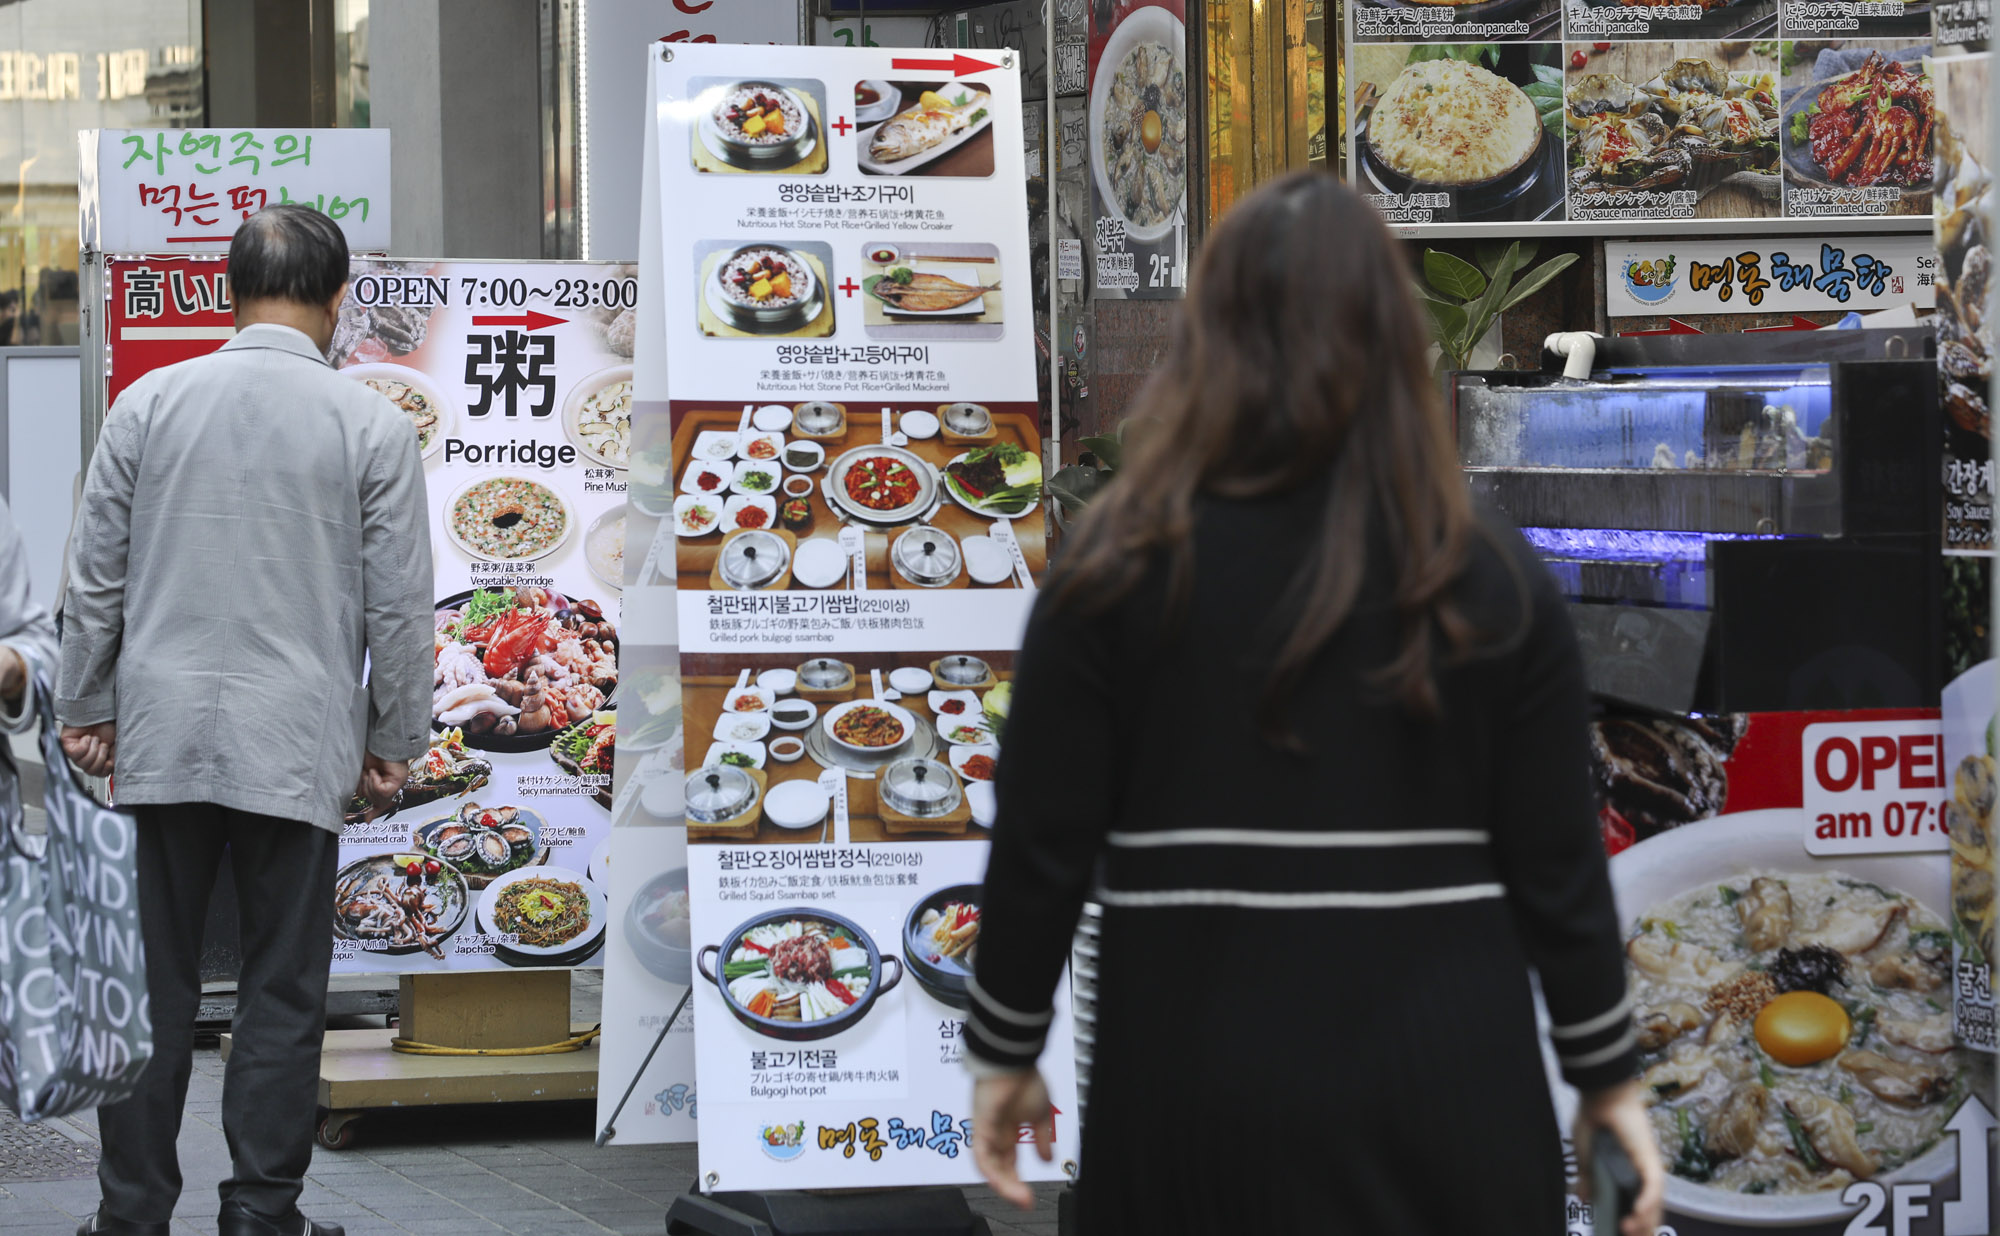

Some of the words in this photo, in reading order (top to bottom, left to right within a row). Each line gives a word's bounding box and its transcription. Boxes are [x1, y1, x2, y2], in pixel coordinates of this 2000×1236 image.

[1358, 22, 1400, 35] Seafood
[1402, 22, 1422, 34] and
[1423, 24, 1453, 37] green
[1454, 22, 1484, 34] onion
[1486, 20, 1528, 35] pancake
[1569, 21, 1604, 33] Kimchi
[1606, 20, 1648, 34] pancake
[1786, 17, 1814, 29] Chive
[1816, 17, 1858, 31] pancake
[121, 131, 311, 175] 자연주의
[778, 184, 914, 203] 영양솥밥+조기구이
[139, 183, 219, 226] 먹는
[1790, 204, 1814, 216] Spicy
[1816, 203, 1863, 214] marinated
[1865, 202, 1886, 213] crab
[1380, 208, 1409, 220] amed
[1411, 211, 1432, 223] egg
[1574, 208, 1591, 220] Soy
[1593, 209, 1620, 218] sauce
[1622, 206, 1670, 218] marinated
[1672, 206, 1693, 217] crab
[737, 219, 777, 229] Nutritious
[780, 220, 795, 229] Hot
[797, 220, 822, 229] Stone
[824, 220, 839, 229] Pot
[892, 221, 918, 230] Yellow
[920, 221, 953, 231] Croaker
[1149, 253, 1170, 288] 2F
[1097, 271, 1118, 286] Abalone
[1118, 271, 1139, 291] Porridge
[355, 276, 450, 307] OPEN
[776, 345, 929, 365] 영양솥밥+고등어구이
[464, 329, 557, 417] 粥
[757, 382, 797, 391] Nutritious
[799, 382, 814, 391] Hot
[817, 382, 842, 391] Stone
[844, 383, 859, 391] Pot
[912, 383, 950, 391] Mackerel
[445, 439, 576, 468] Porridge
[585, 468, 615, 479] 松茸粥
[585, 482, 604, 491] Pine
[470, 576, 515, 586] Vegetable
[516, 575, 554, 586] Porridge
[710, 632, 737, 642] Grilled
[740, 632, 760, 643] pork
[762, 632, 793, 643] bulgogi
[795, 632, 834, 643] ssambap
[518, 786, 538, 796] Spicy
[540, 786, 580, 795] marinated
[581, 785, 599, 795] crab
[1815, 811, 1872, 840] am
[347, 835, 388, 844] marinated
[389, 834, 407, 843] crab
[540, 837, 573, 846] Abalone
[719, 890, 747, 901] Grilled
[750, 890, 775, 901] Squid
[777, 889, 819, 900] Ssambap
[822, 889, 836, 898] set
[332, 951, 354, 961] topus
[455, 945, 495, 955] Japchae
[751, 1049, 838, 1070] 불고기전골
[751, 1085, 789, 1098] Bulgogi
[791, 1085, 807, 1096] hot
[810, 1085, 827, 1098] pot
[1842, 1181, 1932, 1236] 2F
